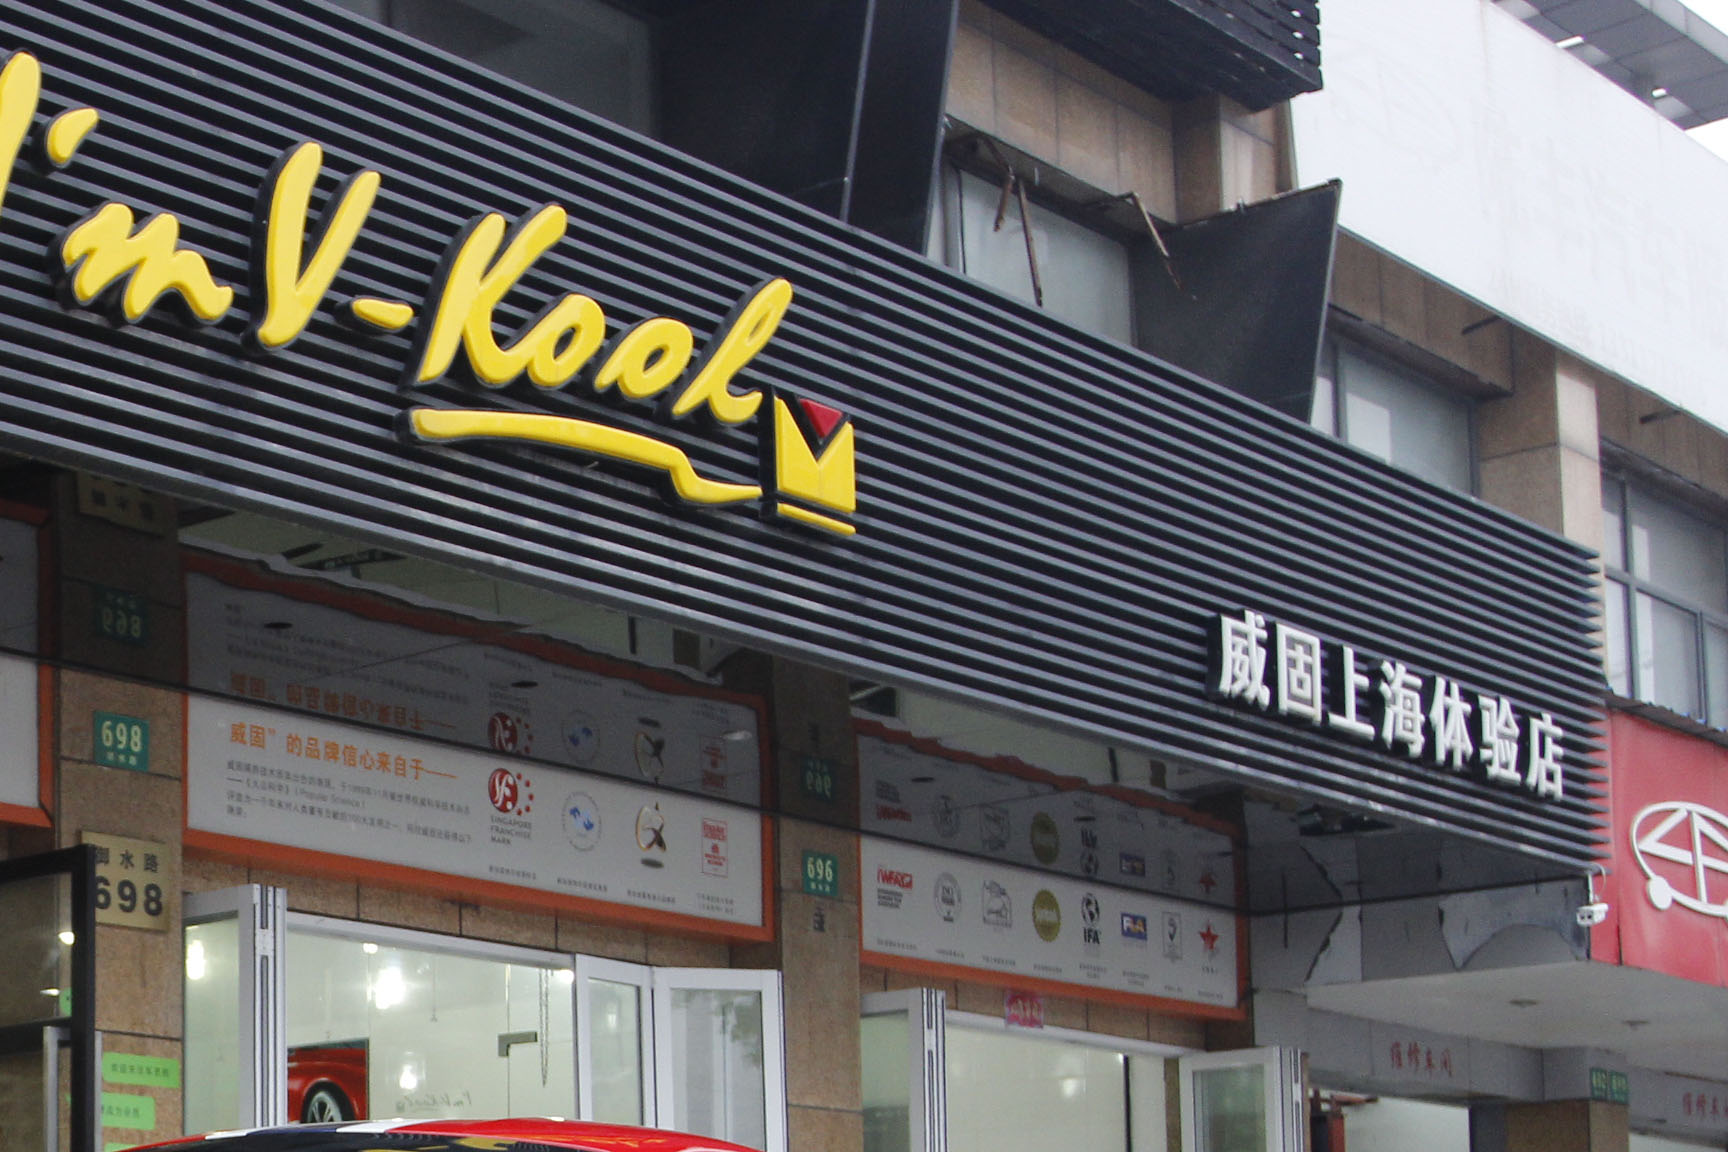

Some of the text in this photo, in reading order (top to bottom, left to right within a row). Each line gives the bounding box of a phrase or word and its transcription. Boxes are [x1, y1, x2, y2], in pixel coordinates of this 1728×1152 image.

[257, 140, 794, 424] V-Kool
[1218, 608, 1565, 799] 威固上海体验店
[102, 720, 142, 752] 698
[807, 857, 833, 883] 696
[95, 875, 163, 917] 698
[1083, 926, 1101, 945] IFA
